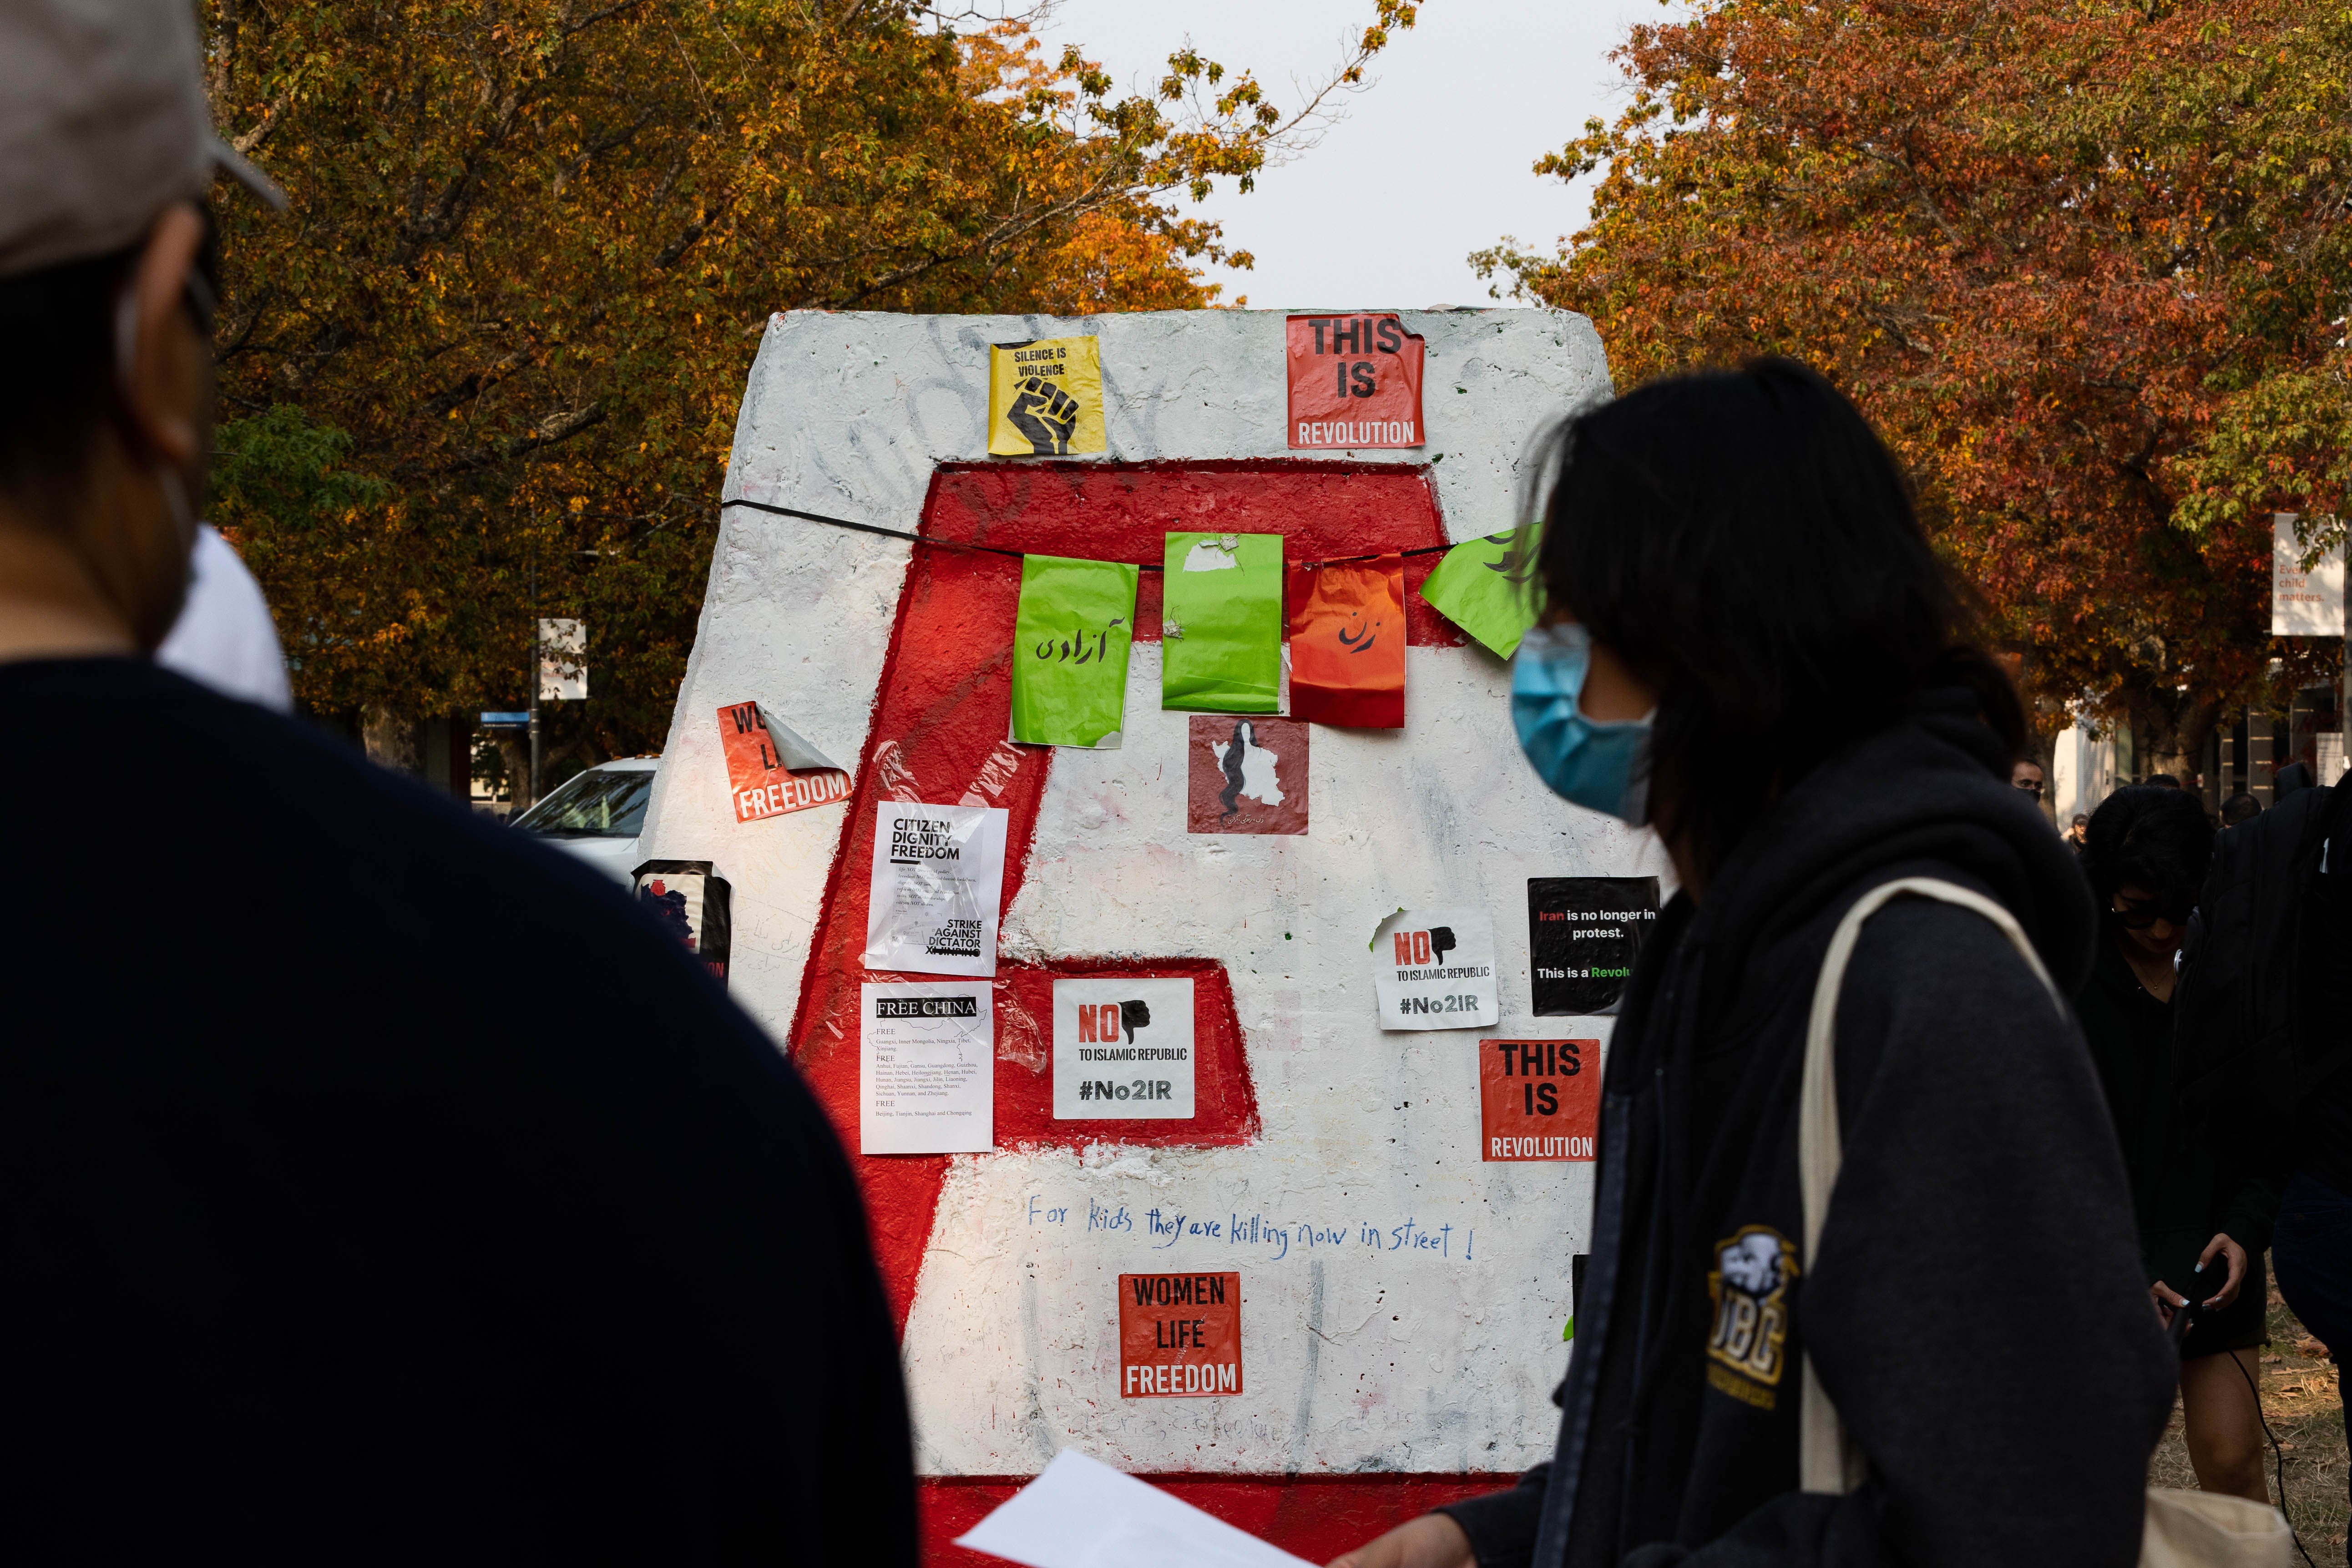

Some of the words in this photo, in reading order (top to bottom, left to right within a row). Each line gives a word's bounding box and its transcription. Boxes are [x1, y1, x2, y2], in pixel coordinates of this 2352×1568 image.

[1309, 318, 1401, 354] THIS
[1014, 349, 1054, 362] SILENCE
[1057, 347, 1066, 358] IS
[1018, 364, 1064, 377] VIOLENCE
[1338, 361, 1376, 398] IS
[1299, 421, 1414, 444] REVOLUTION
[2279, 578, 2305, 588] child
[2279, 593, 2324, 602] matters.
[1036, 617, 1125, 665] آزادی
[1339, 612, 1381, 654] زن
[739, 772, 847, 818] FREEDOM
[893, 818, 951, 834] CITIZEN
[892, 831, 953, 846] DIGNITY
[891, 844, 960, 860] FREEDOM
[947, 919, 982, 929] STRIKE
[1539, 911, 1564, 921] Iran
[1567, 910, 1578, 921] is
[1581, 912, 1597, 921] no
[1600, 910, 1641, 922] longer
[1644, 909, 1656, 919] in
[929, 936, 981, 948] DICTATOR
[935, 927, 982, 939] AGAINST
[1573, 928, 1624, 941] protest.
[1394, 931, 1431, 966] NO
[1396, 971, 1408, 981] TO
[1410, 968, 1446, 981] ISLAMIC
[1448, 966, 1490, 979] REPUBLIC
[1538, 967, 1564, 978] This
[1567, 967, 1578, 978] is
[1581, 969, 1589, 978] a
[1591, 966, 1631, 977] Revolu
[877, 1002, 919, 1015] FREE
[923, 1001, 976, 1014] CHINA
[1400, 995, 1479, 1014] #No2IR
[1079, 1004, 1119, 1042] NO
[1079, 1048, 1092, 1061] TO
[1094, 1048, 1136, 1061] ISLAMIC
[1138, 1048, 1187, 1061] REPUBLIC
[1498, 1043, 1581, 1077] THIS
[1079, 1080, 1173, 1100] #No2IR
[1525, 1082, 1558, 1116] IS
[1492, 1137, 1593, 1157] REVOLUTION
[1029, 1194, 1068, 1226] For
[1145, 1208, 1187, 1249] they
[1189, 1219, 1221, 1238] are
[1297, 1224, 1347, 1247] now
[1361, 1221, 1381, 1249] in
[1133, 1276, 1224, 1306] WOMEN
[1156, 1320, 1205, 1348] LIFE
[1127, 1363, 1237, 1394] FREEDOM
